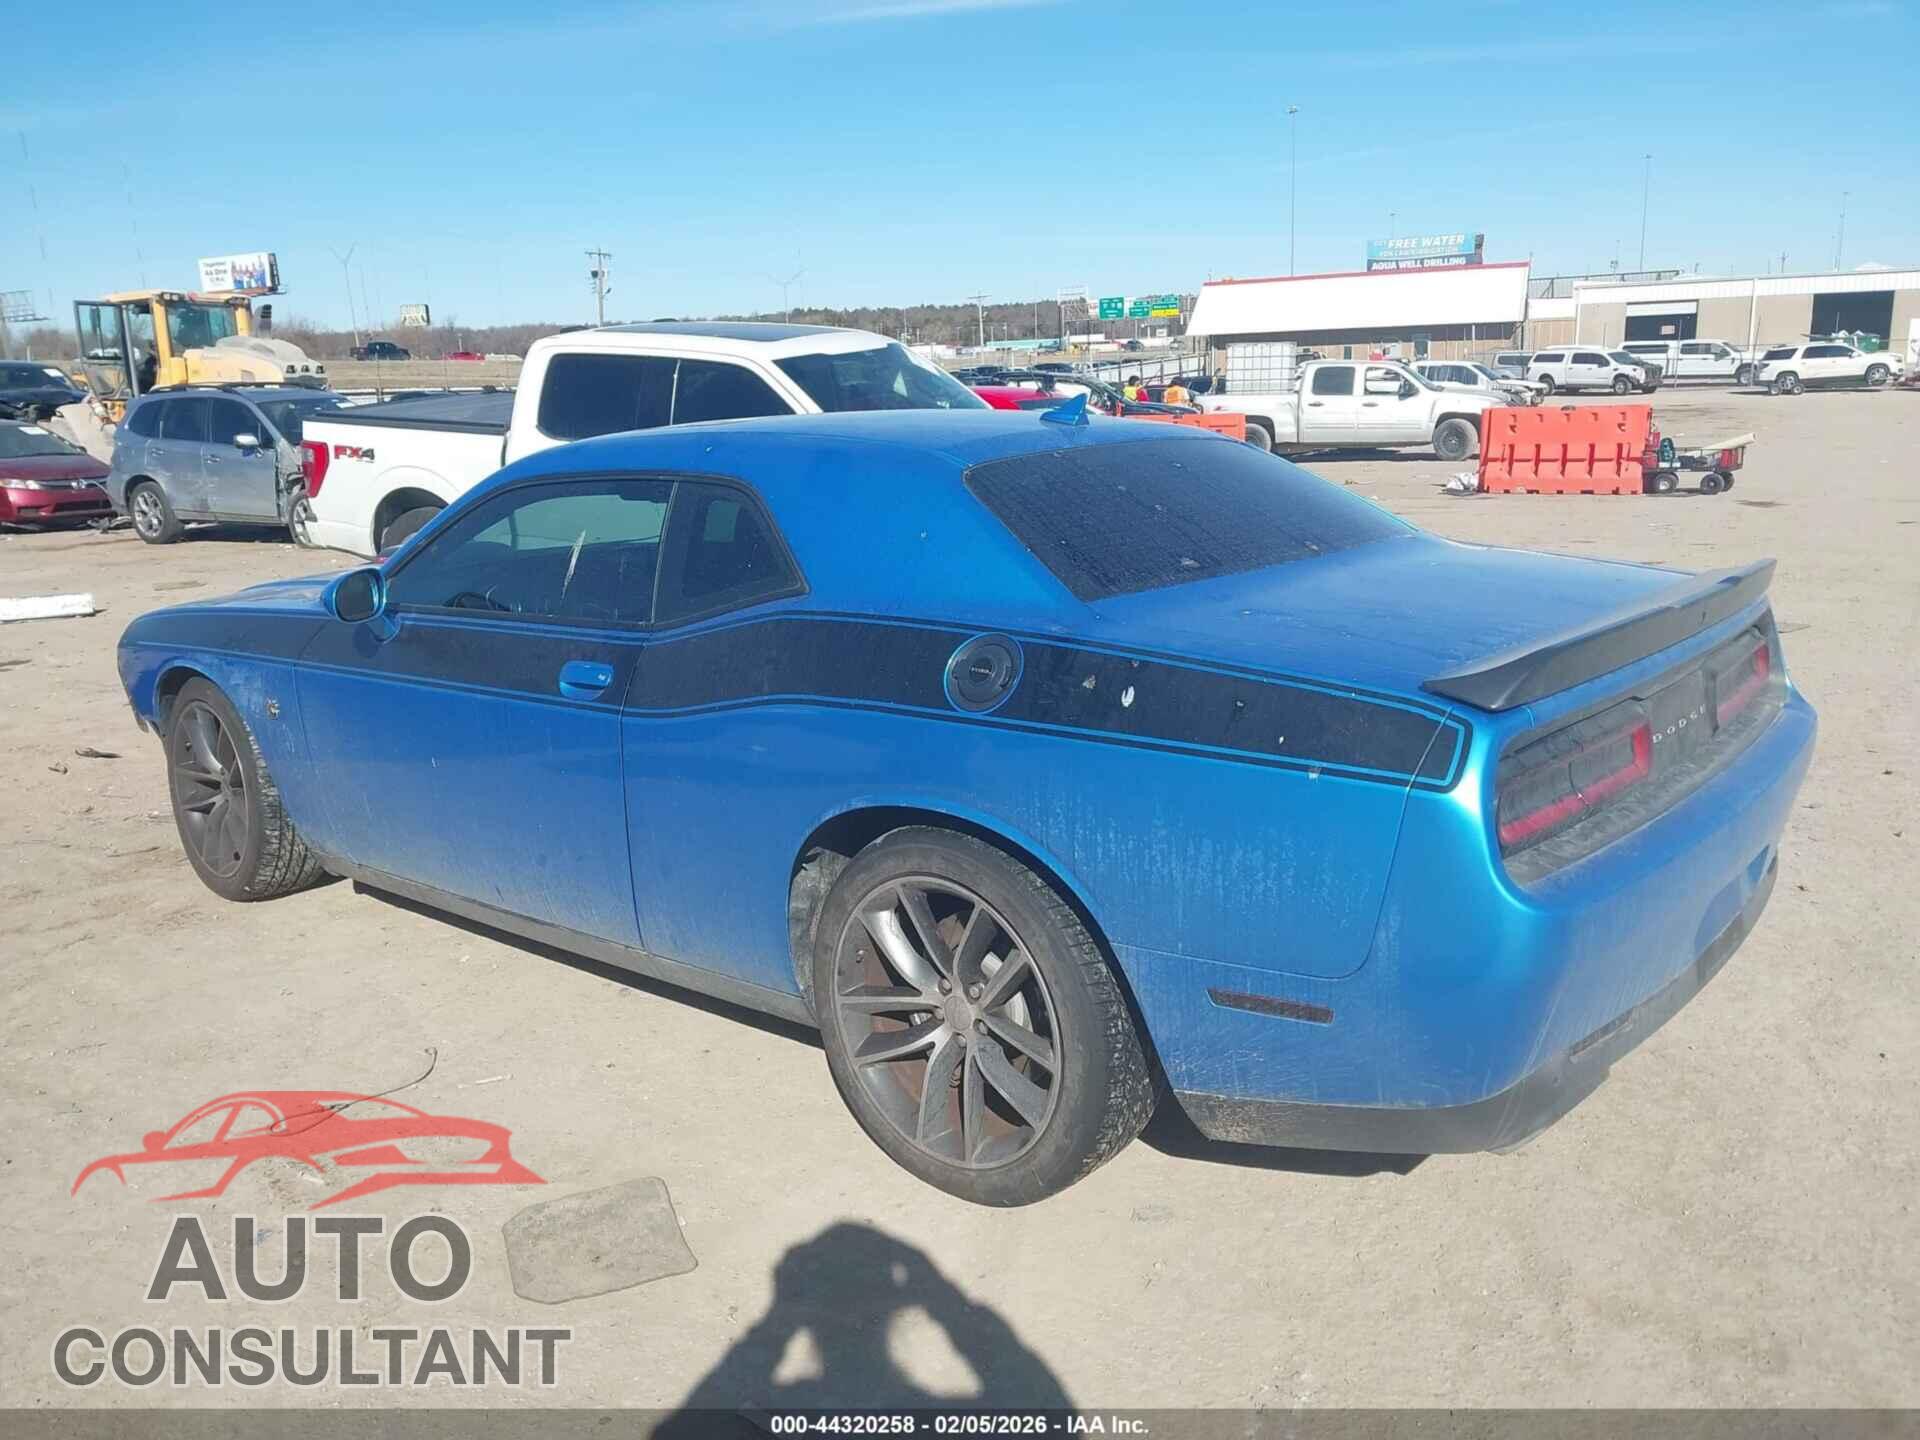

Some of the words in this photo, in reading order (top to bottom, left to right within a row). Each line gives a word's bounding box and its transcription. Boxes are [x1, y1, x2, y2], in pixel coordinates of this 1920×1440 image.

[1387, 238, 1417, 249] FREE
[1422, 234, 1465, 247] WATER
[1371, 261, 1397, 271] AQUA
[1398, 259, 1422, 269] WELL
[1423, 256, 1466, 268] DRILLING
[334, 445, 375, 460] FX4
